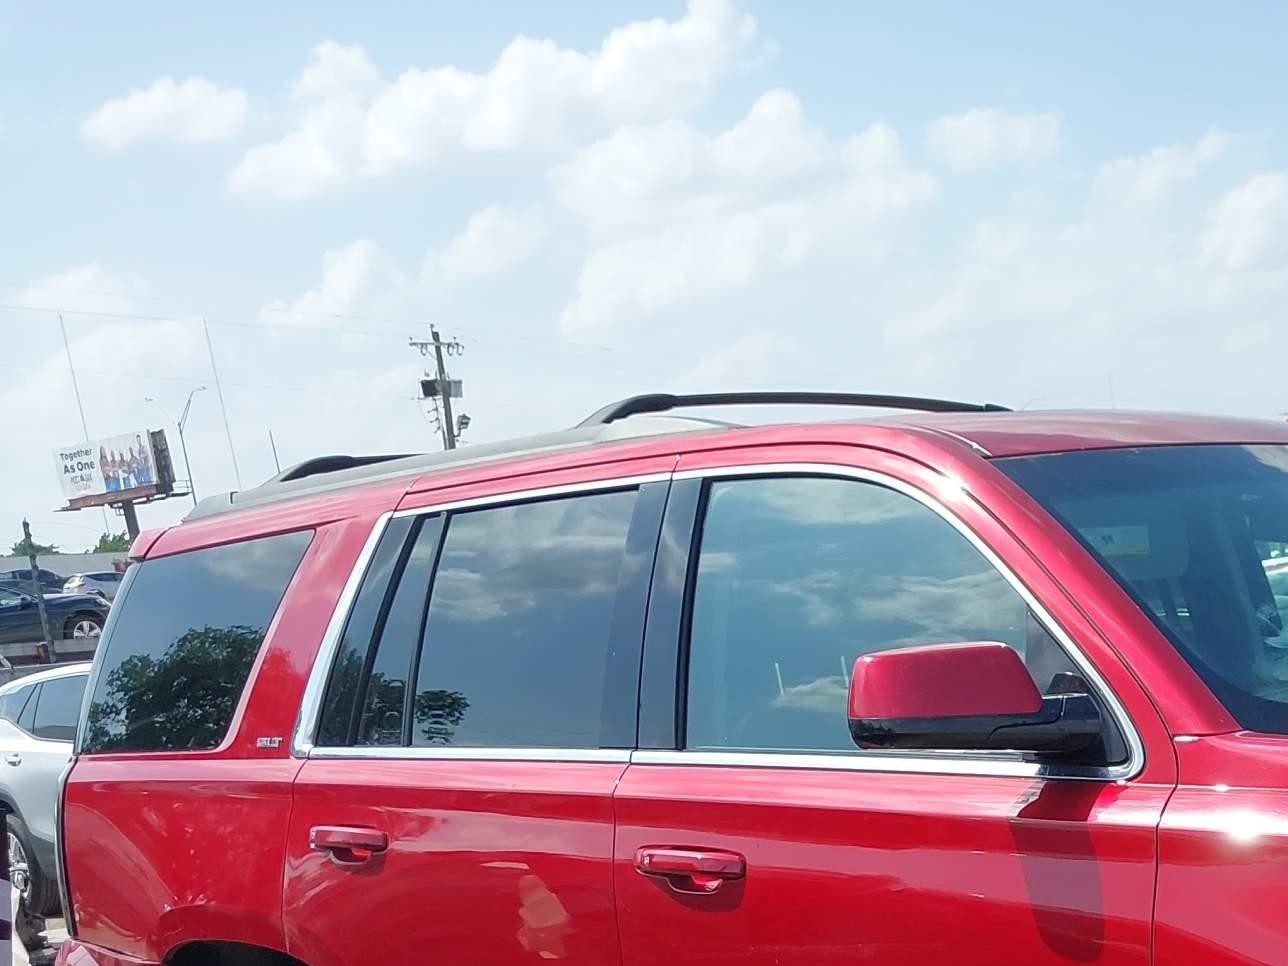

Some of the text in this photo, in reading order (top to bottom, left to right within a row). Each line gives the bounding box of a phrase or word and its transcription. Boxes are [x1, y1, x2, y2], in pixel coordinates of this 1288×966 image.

[60, 449, 92, 462] Together
[64, 461, 96, 474] As One
[256, 737, 282, 748] SLT
